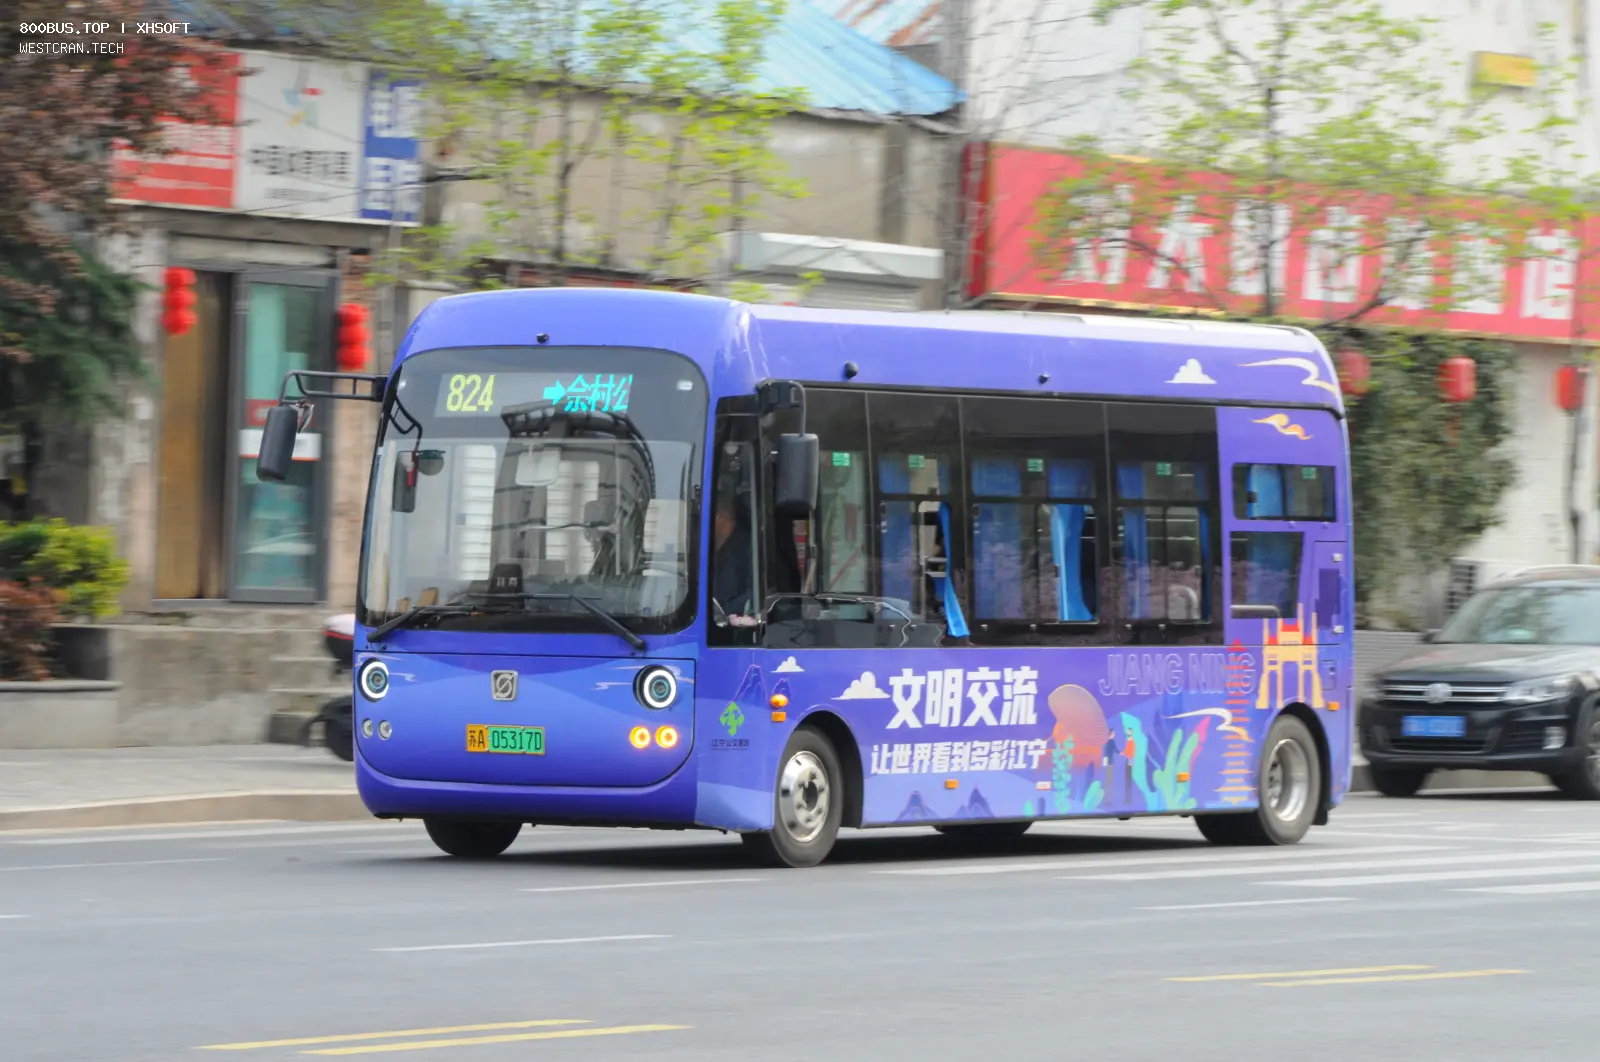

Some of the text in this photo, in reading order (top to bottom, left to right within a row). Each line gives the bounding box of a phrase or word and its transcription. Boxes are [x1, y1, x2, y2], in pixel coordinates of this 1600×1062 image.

[446, 374, 496, 412] 824
[1098, 653, 1256, 696] JIANG NING
[885, 666, 1038, 729] 文明交流
[871, 738, 1047, 775] 让世界看到多彩江宁
